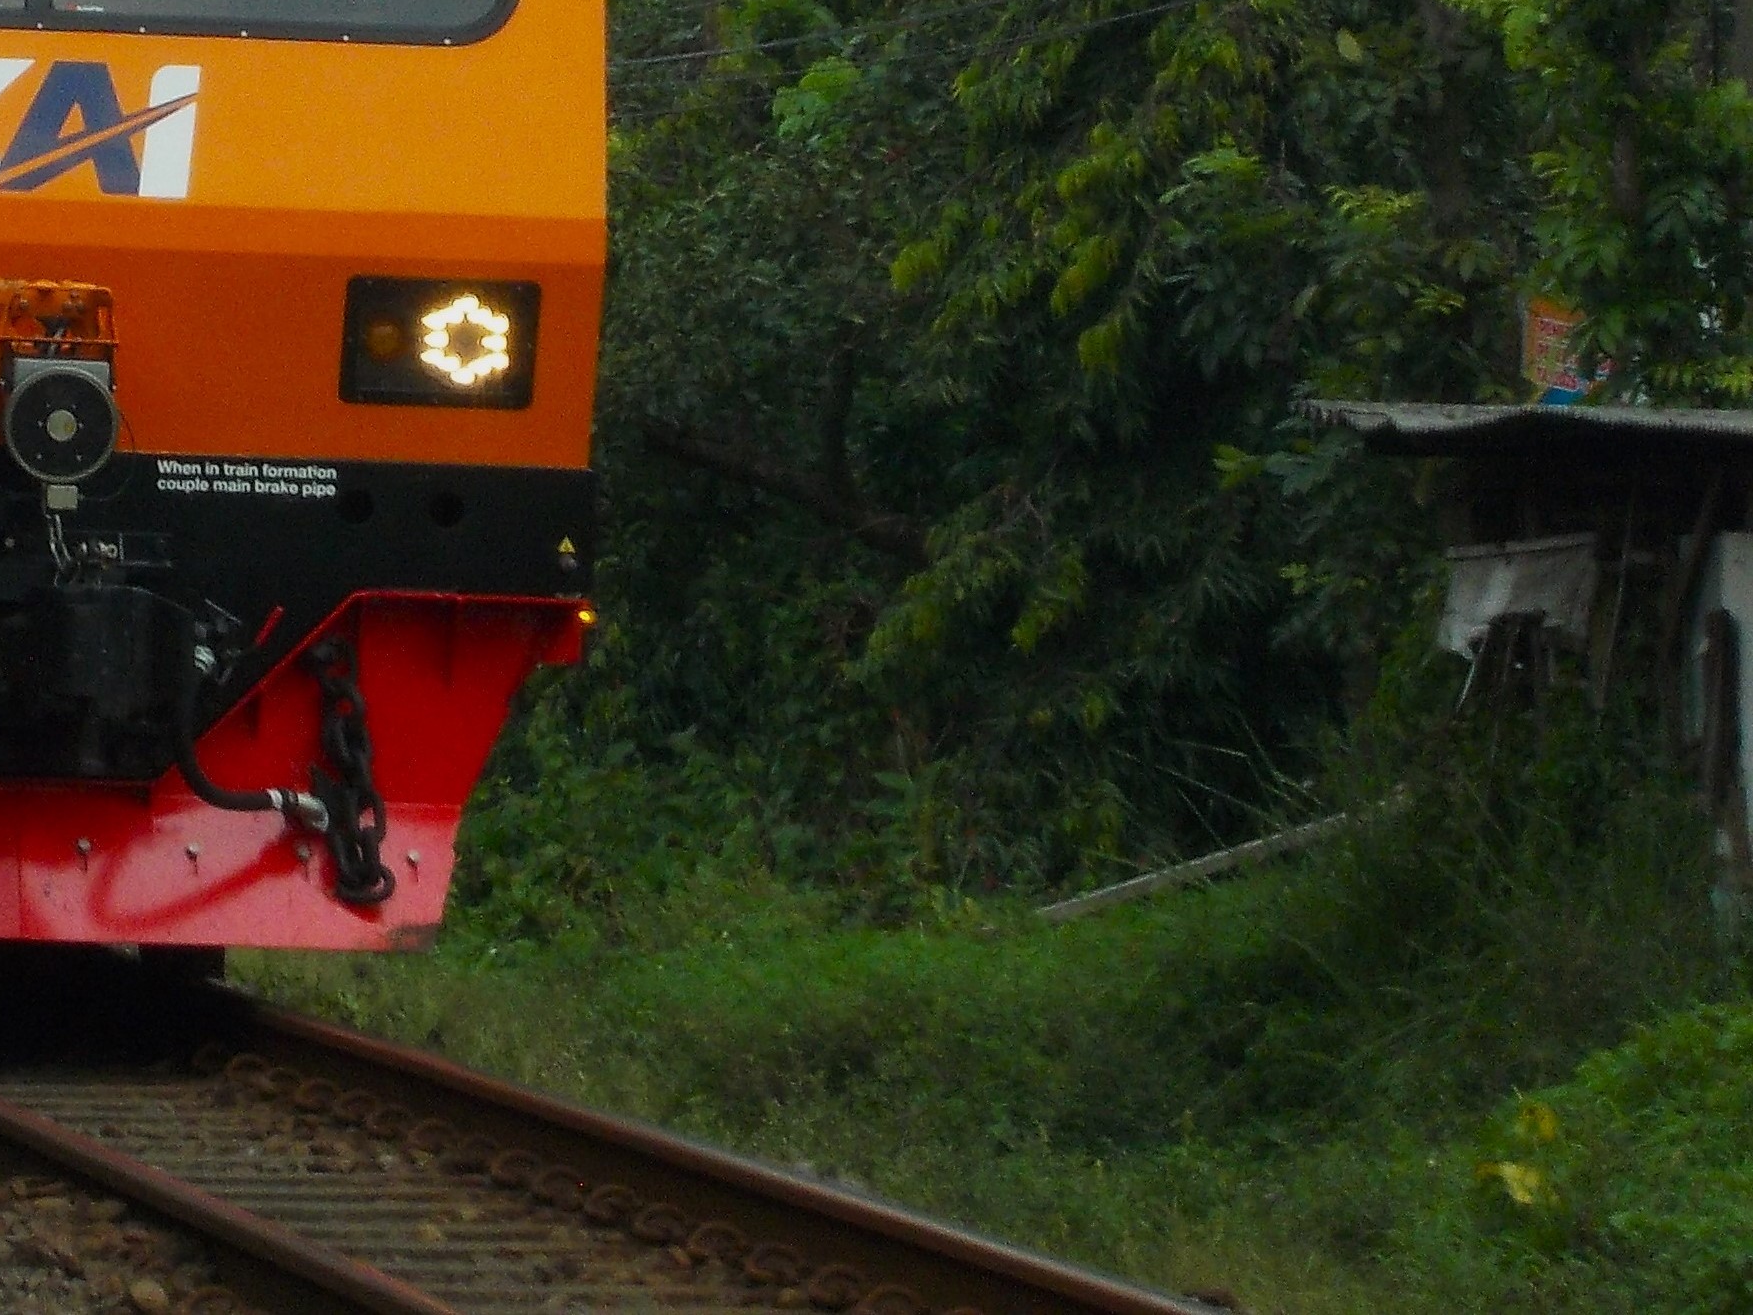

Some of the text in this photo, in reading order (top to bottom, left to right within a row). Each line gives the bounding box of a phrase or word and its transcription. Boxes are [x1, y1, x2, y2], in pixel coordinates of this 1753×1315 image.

[157, 459, 338, 480] When in train formation
[157, 476, 337, 499] couple main brake pipe
